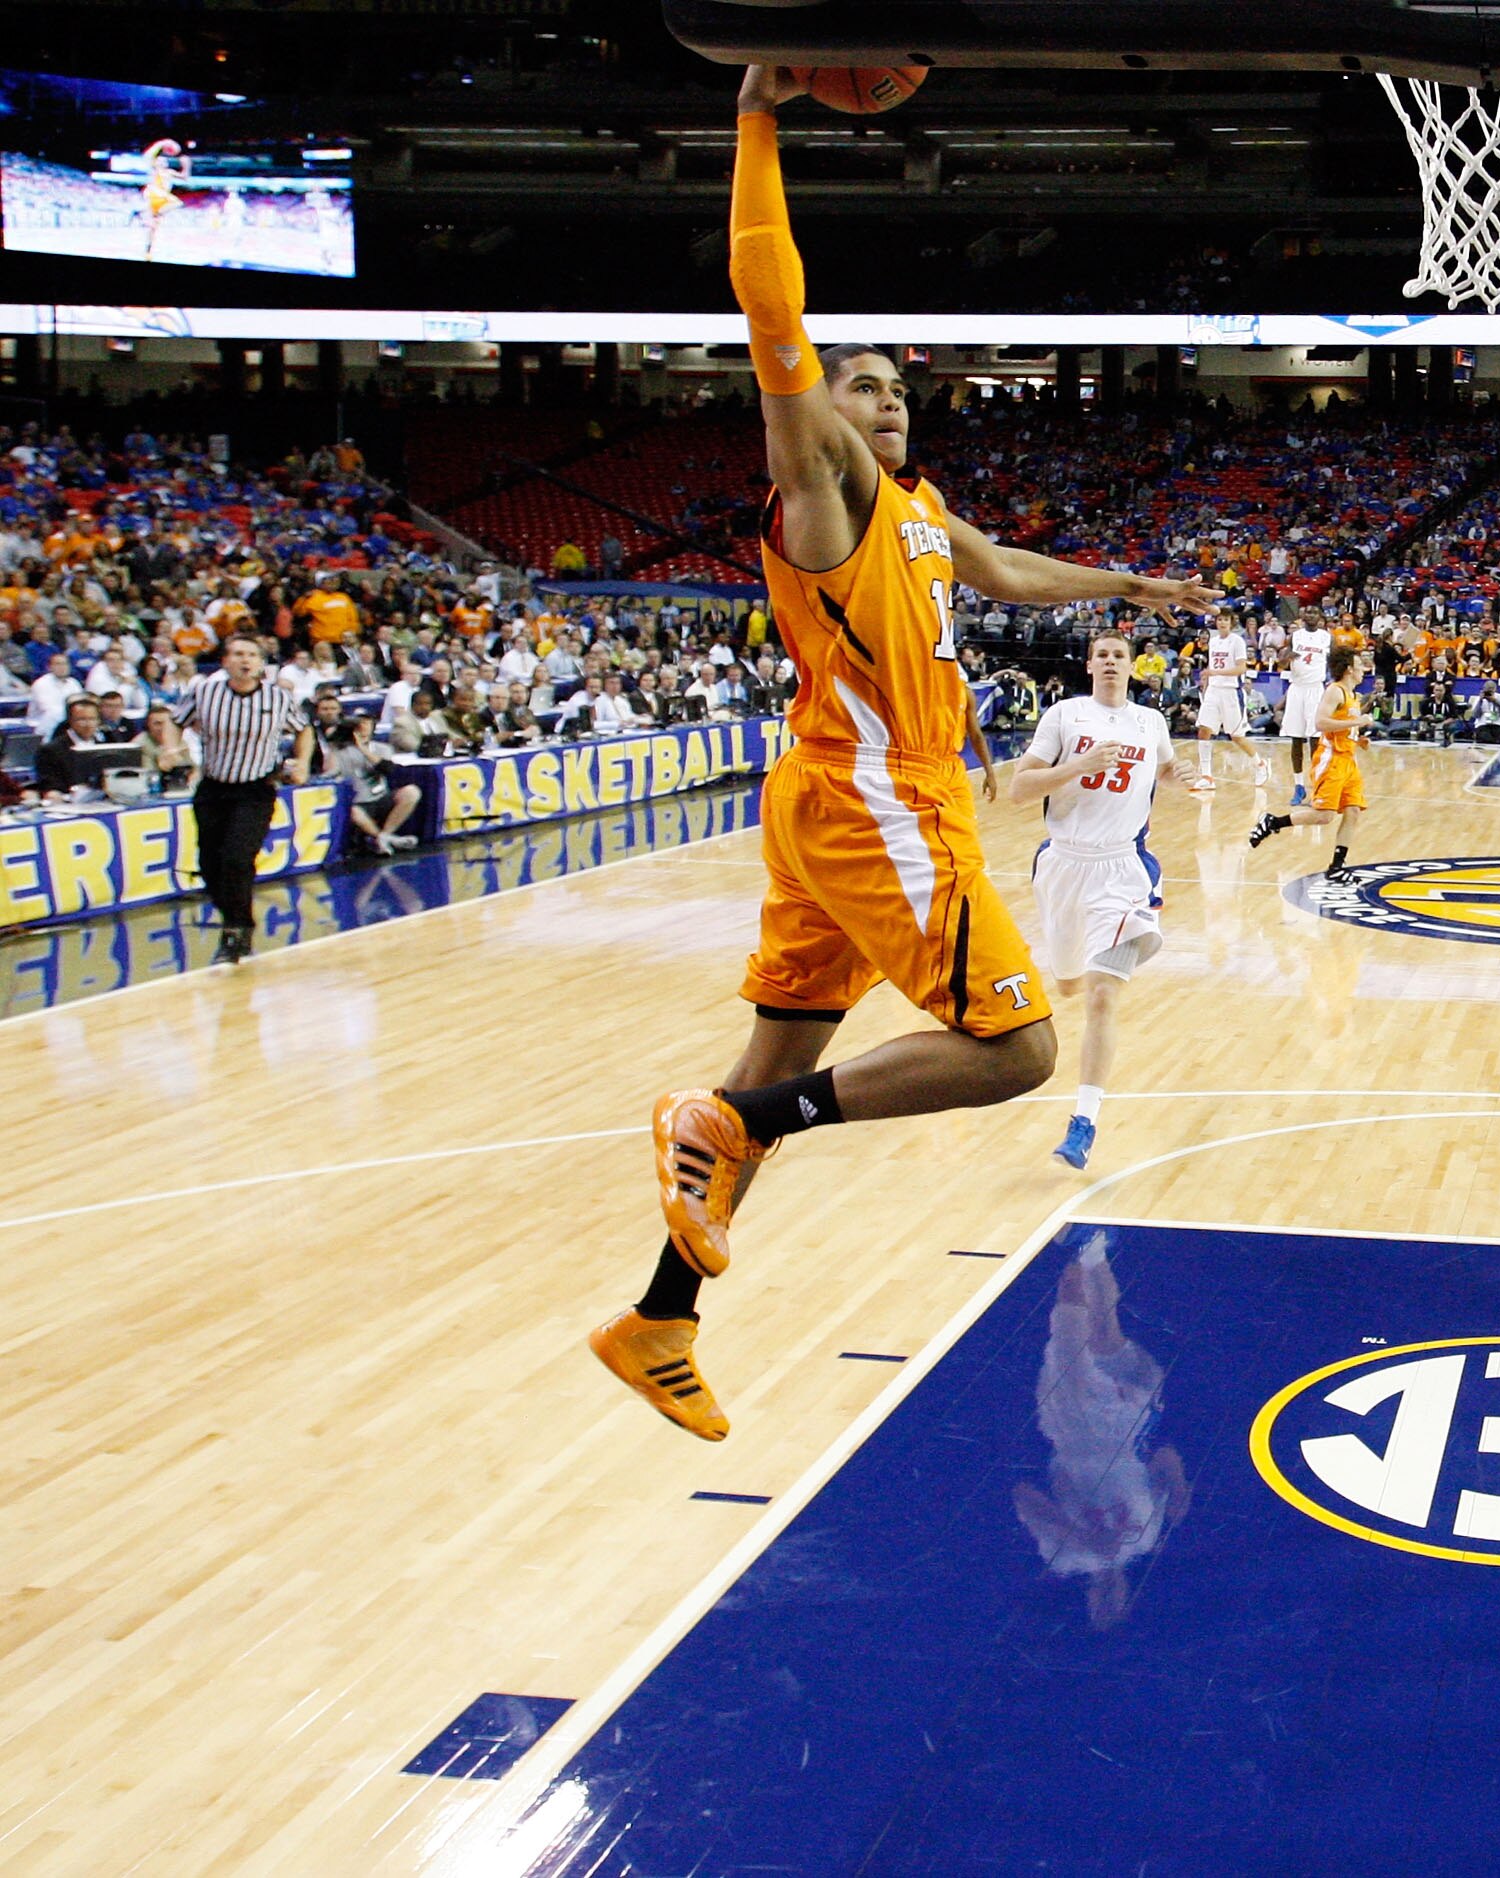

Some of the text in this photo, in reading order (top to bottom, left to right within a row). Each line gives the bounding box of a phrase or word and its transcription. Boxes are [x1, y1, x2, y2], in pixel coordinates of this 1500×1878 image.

[1213, 657, 1225, 669] 25
[1303, 652, 1313, 665] 4
[442, 724, 752, 836] BASKETBALL
[0, 785, 338, 926] ERECE
[992, 972, 1030, 1011] T
